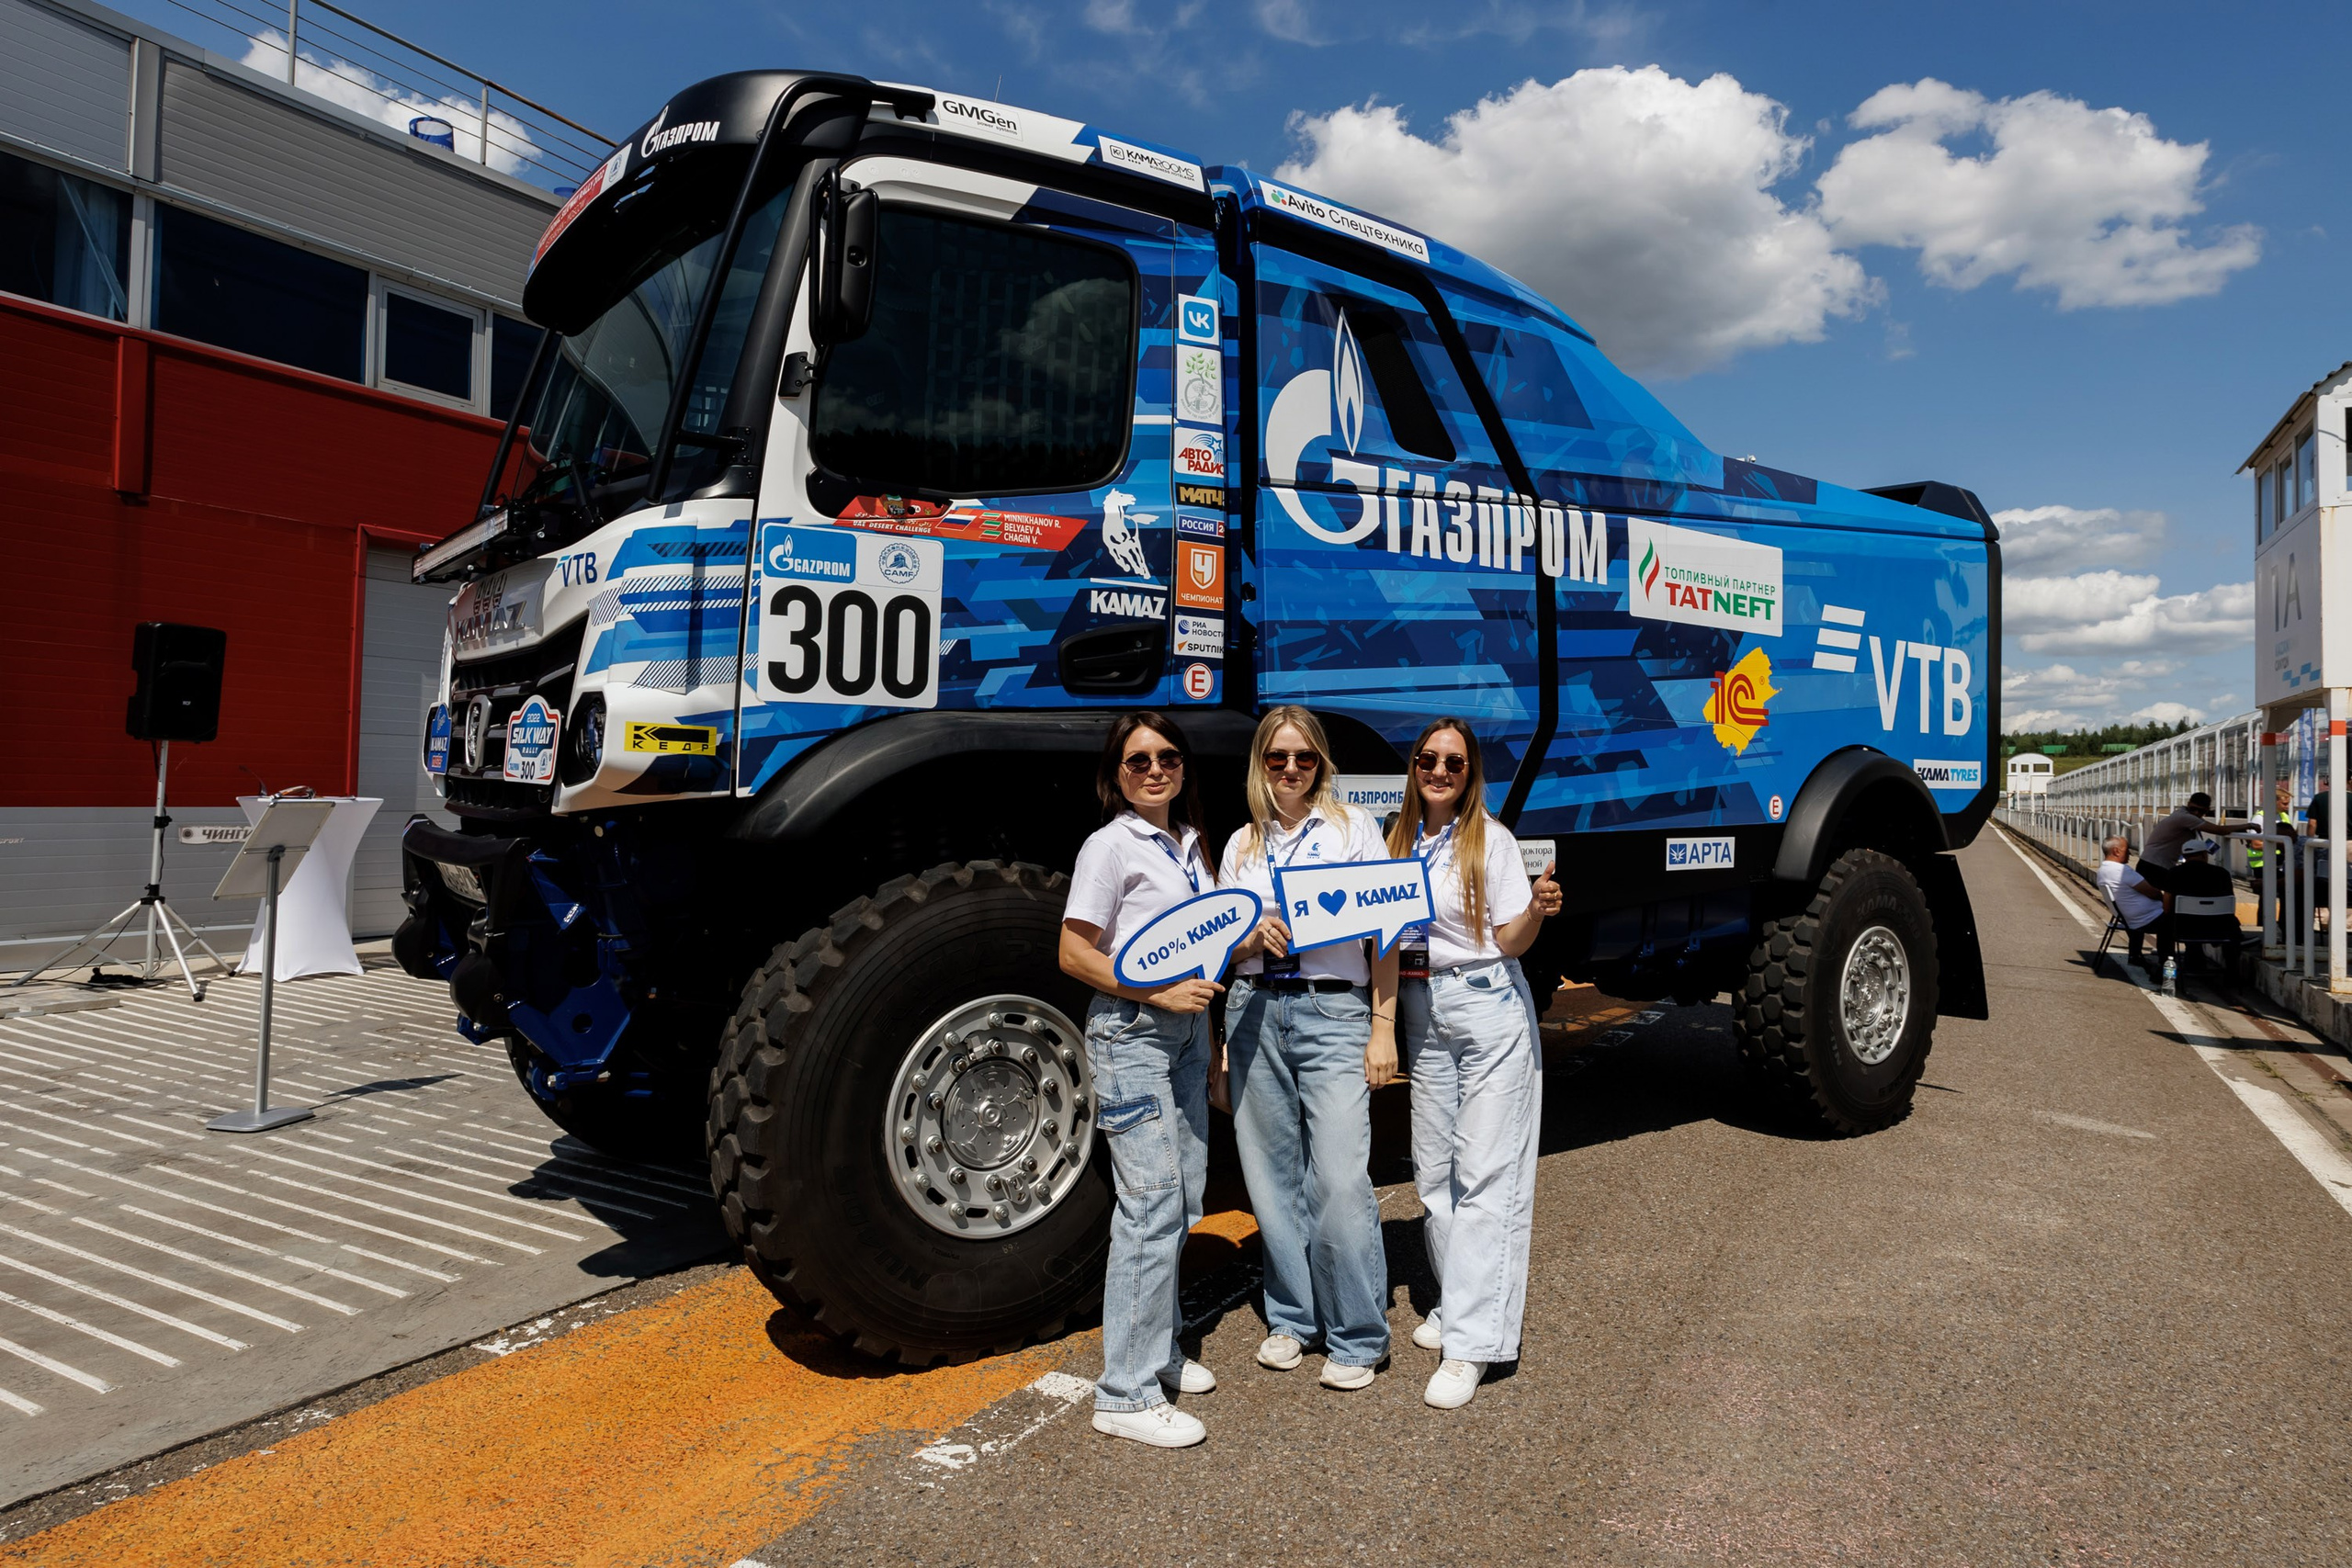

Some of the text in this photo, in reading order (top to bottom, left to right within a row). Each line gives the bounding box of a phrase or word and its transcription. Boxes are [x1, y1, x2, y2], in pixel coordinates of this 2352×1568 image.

[943, 100, 1017, 130] GMGen
[655, 121, 720, 152] ГАЗПРОМ
[1126, 150, 1194, 178] KAMAROOMS
[1288, 195, 1424, 255] Avito Спецтехника
[1188, 310, 1210, 330] VK
[1178, 447, 1212, 462] АВТО
[895, 525, 932, 534] CHALLENGE
[1004, 513, 1061, 528] MINNIKHANOV R.
[1004, 523, 1043, 536] BELYAEV A.
[1182, 519, 1215, 532] РОССИЯ
[1385, 467, 1608, 585] ГАЗПРОМ
[1003, 532, 1038, 545] CHAGIN V.
[562, 552, 597, 587] VTB
[794, 557, 851, 577] GAZPROM
[884, 570, 914, 578] CAMF
[1665, 566, 1776, 596] ТОПЛИВНЫЙ ПАРТНЕР
[1091, 590, 1166, 620] KAMAZ
[1181, 592, 1223, 604] ЧЕМПИОНАТ
[1665, 581, 1775, 621] TATNEFT
[456, 601, 527, 645] KAMAZ
[1193, 621, 1206, 629] РИА
[768, 585, 931, 699] 300
[1187, 643, 1225, 654] SPUTNIK
[1192, 670, 1205, 693] E
[1869, 636, 1973, 736] VTB
[526, 713, 540, 723] 2022
[431, 737, 447, 751] KAMAZ
[521, 761, 535, 780] 300
[1917, 767, 1978, 782] KAMA TYRES
[1772, 799, 1780, 815] E
[1688, 842, 1732, 863] АРТА
[1294, 882, 1420, 919] Я KAMAZ
[1136, 906, 1242, 971] 100% KAMAZ
